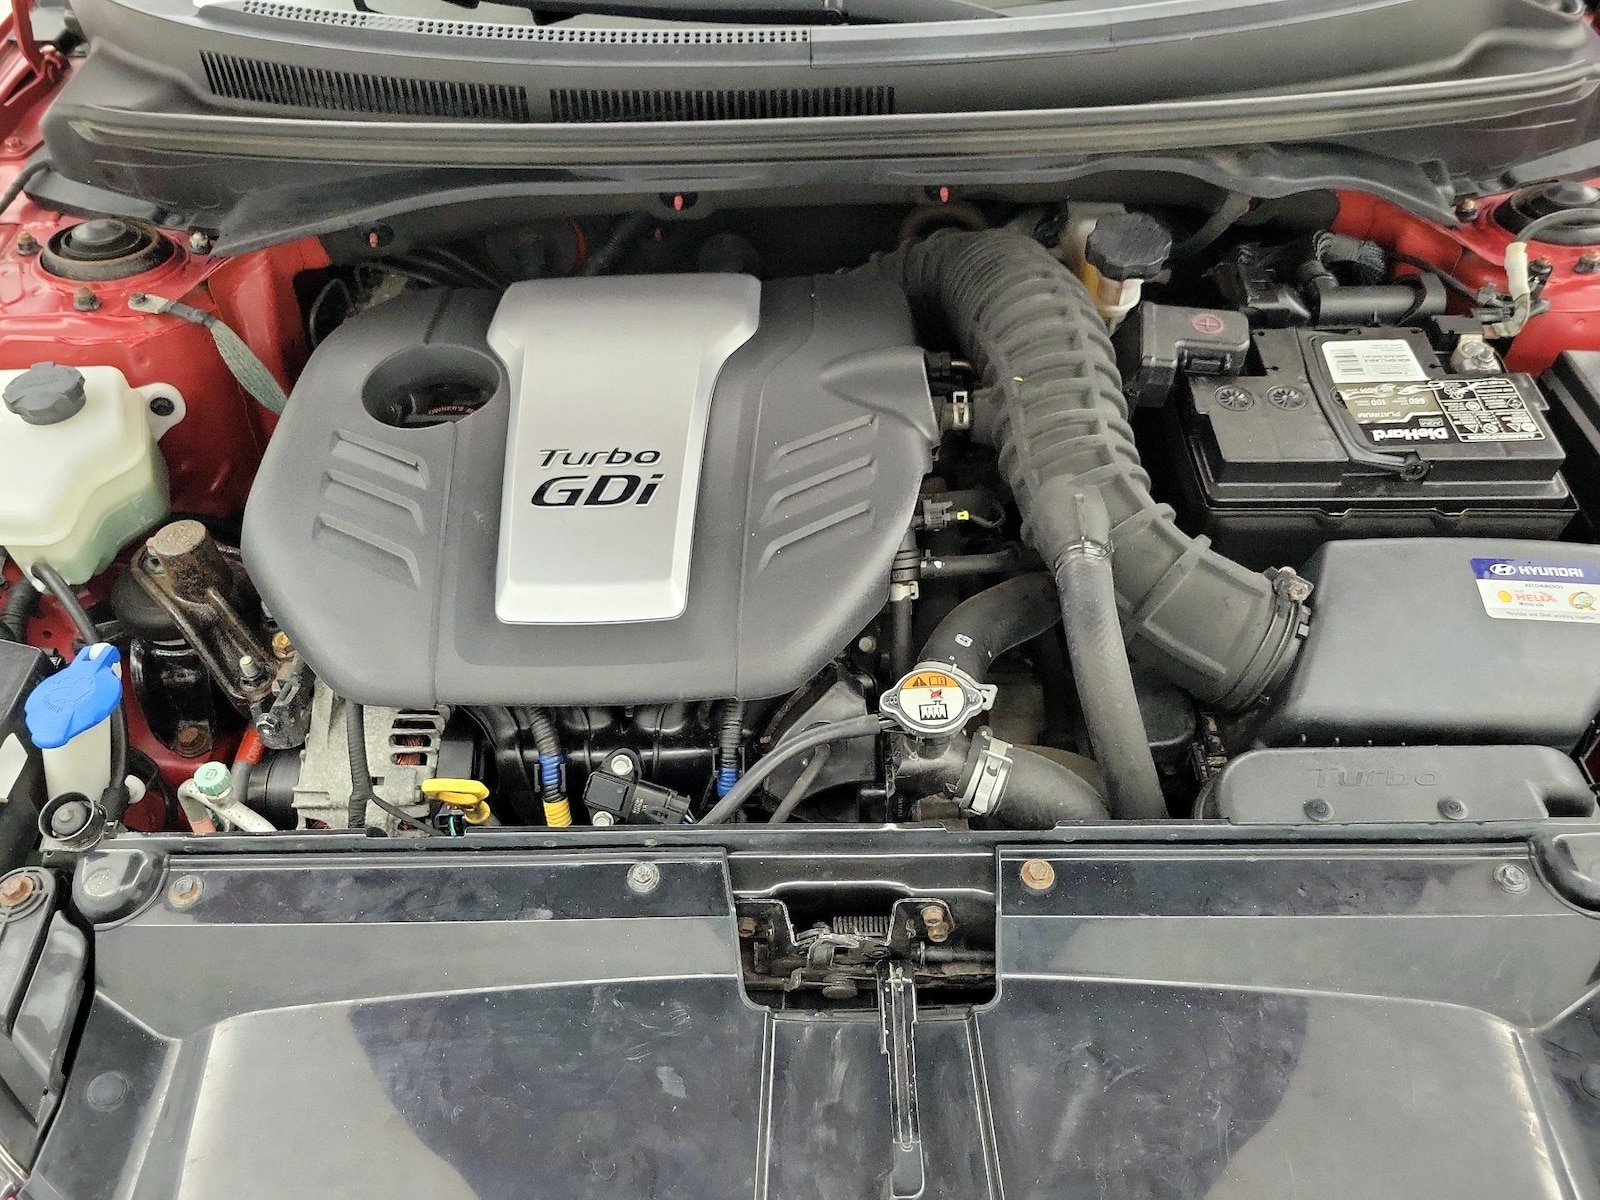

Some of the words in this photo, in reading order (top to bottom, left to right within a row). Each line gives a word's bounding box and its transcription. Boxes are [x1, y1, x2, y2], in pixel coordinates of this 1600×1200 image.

[1370, 398, 1387, 406] 100
[1371, 427, 1449, 442] DieHard
[539, 447, 661, 468] Turbo
[530, 473, 666, 508] GDi
[1518, 565, 1585, 578] HYUNDAI
[1307, 766, 1441, 788] Turbo
